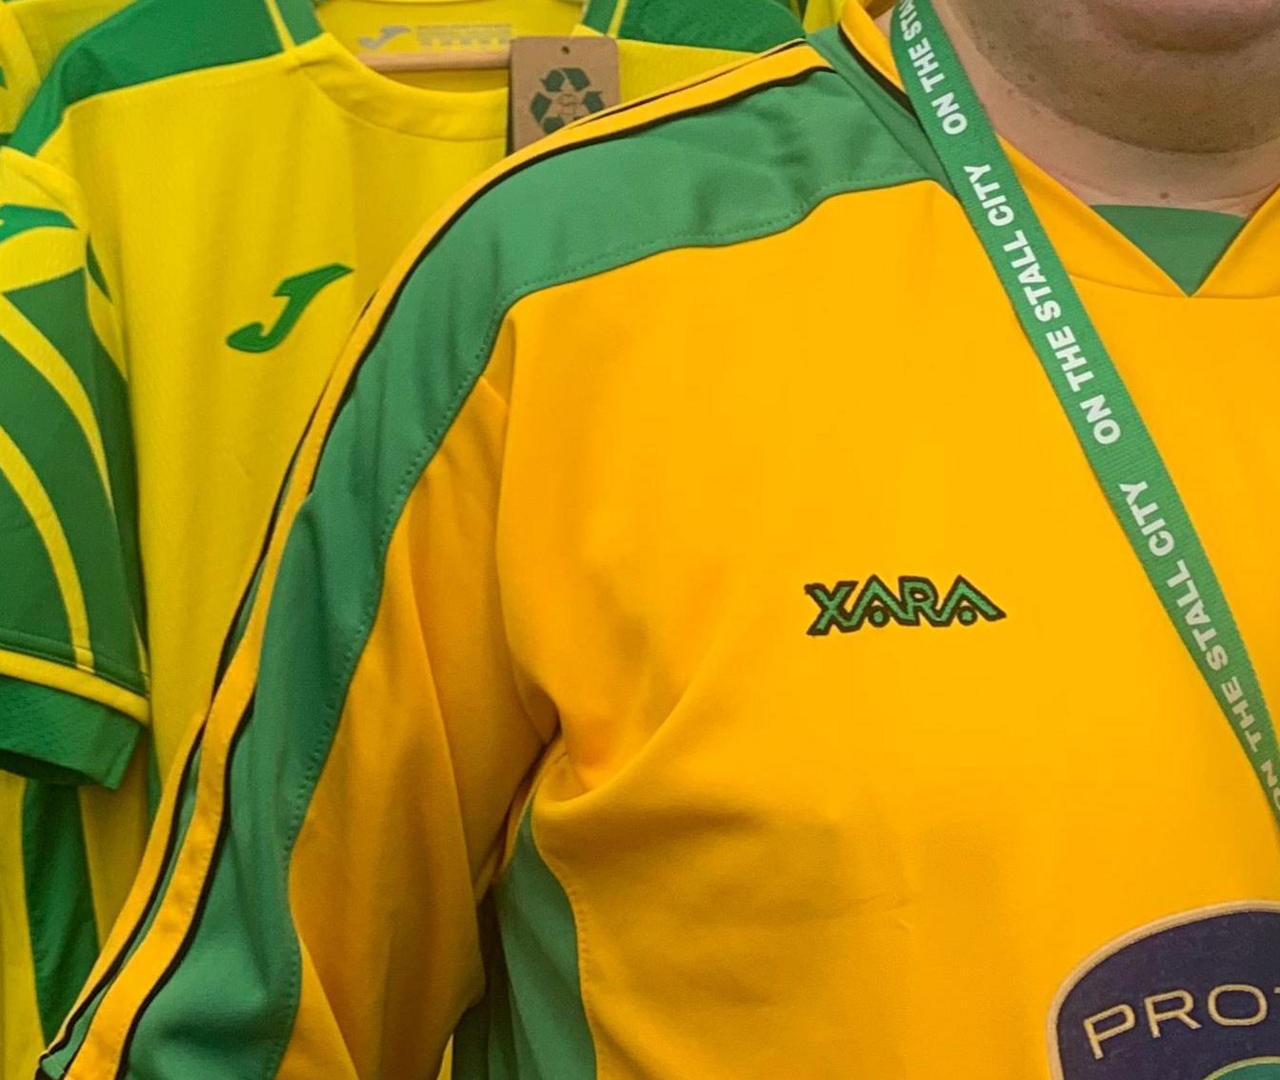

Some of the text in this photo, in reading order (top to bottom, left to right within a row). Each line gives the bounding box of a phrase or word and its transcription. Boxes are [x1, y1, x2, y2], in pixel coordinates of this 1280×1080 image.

[907, 37, 946, 94] THE
[930, 91, 969, 136] ON
[962, 162, 1122, 446] ON THE STALL CITY
[1118, 479, 1177, 558] CITY
[803, 573, 1008, 637] XARA
[1165, 559, 1230, 672] STALL
[1220, 675, 1263, 754] THE
